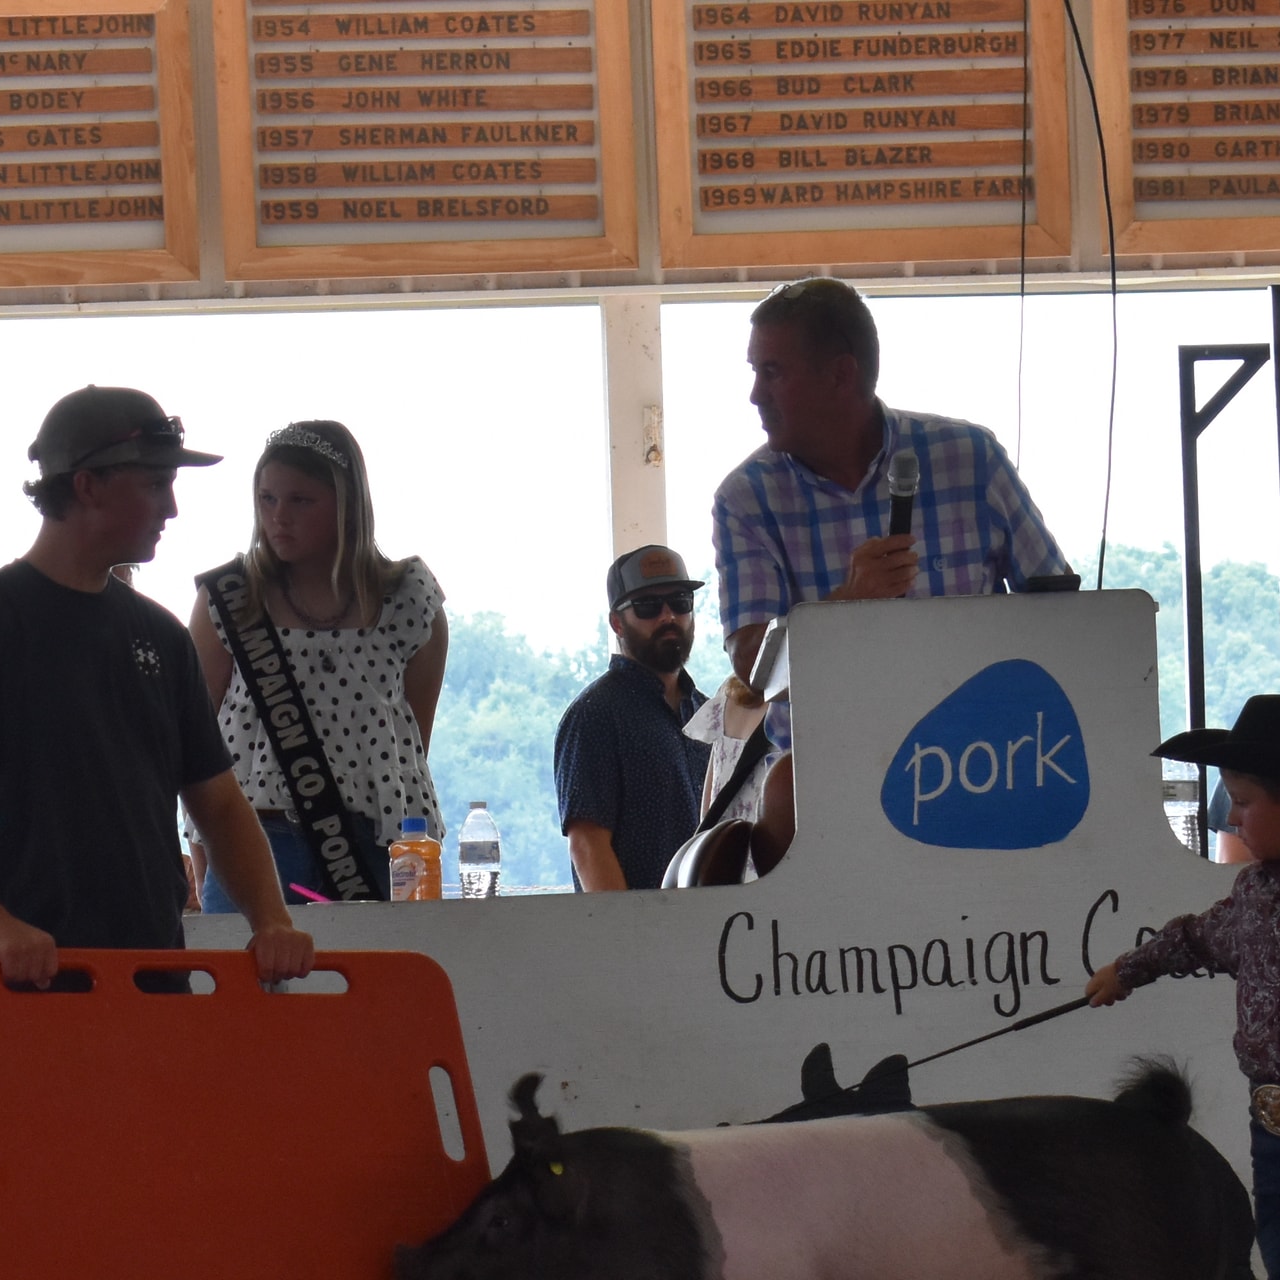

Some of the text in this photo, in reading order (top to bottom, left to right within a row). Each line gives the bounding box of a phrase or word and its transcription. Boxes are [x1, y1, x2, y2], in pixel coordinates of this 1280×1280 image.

[694, 1, 951, 25] 1964 DAVID RUNYAN
[1133, 0, 1187, 14] 1976
[1210, 0, 1255, 13] DON
[7, 15, 149, 37] LITTLEJOHN
[256, 15, 536, 37] 1954 WILLIAM COATES
[697, 35, 1017, 61] 1965 EDDIE FUNDERBURGH
[1134, 33, 1185, 51] 1977
[1209, 30, 1259, 49] NEIL
[258, 52, 511, 74] 1955 GENE HERRON
[698, 74, 915, 97] 1966 BUD CLARK
[1134, 69, 1188, 87] 1978
[1212, 66, 1278, 85] BRIAN
[10, 91, 84, 110] BODEY
[259, 88, 488, 110] 1956 JOHN WHITE
[699, 109, 957, 133] 1967 DAVID RUNYAN
[1136, 106, 1191, 124] 1979
[1213, 103, 1280, 122] BRIAN
[27, 127, 102, 147] GATES
[260, 124, 578, 147] 1957 SHERMAN FAULKNER
[700, 146, 933, 169] 1968 BILL BLAZER
[1137, 142, 1191, 159] 1980
[17, 161, 160, 183] LITTLEJOHN
[263, 160, 542, 184] 1958 WILLIAM COATES
[702, 186, 756, 205] 1969
[761, 184, 824, 202] WARD
[836, 180, 962, 200] HAMPSHIRE
[1137, 178, 1186, 196] 1981
[1209, 177, 1280, 195] PAULA
[20, 198, 163, 220] LITTLEJOHN
[264, 197, 550, 220] 1959 NOEL BRELSFORD
[904, 711, 1078, 826] pork
[290, 755, 326, 811] CO.
[311, 815, 371, 901] PORK
[718, 911, 1061, 1017] Champaign
